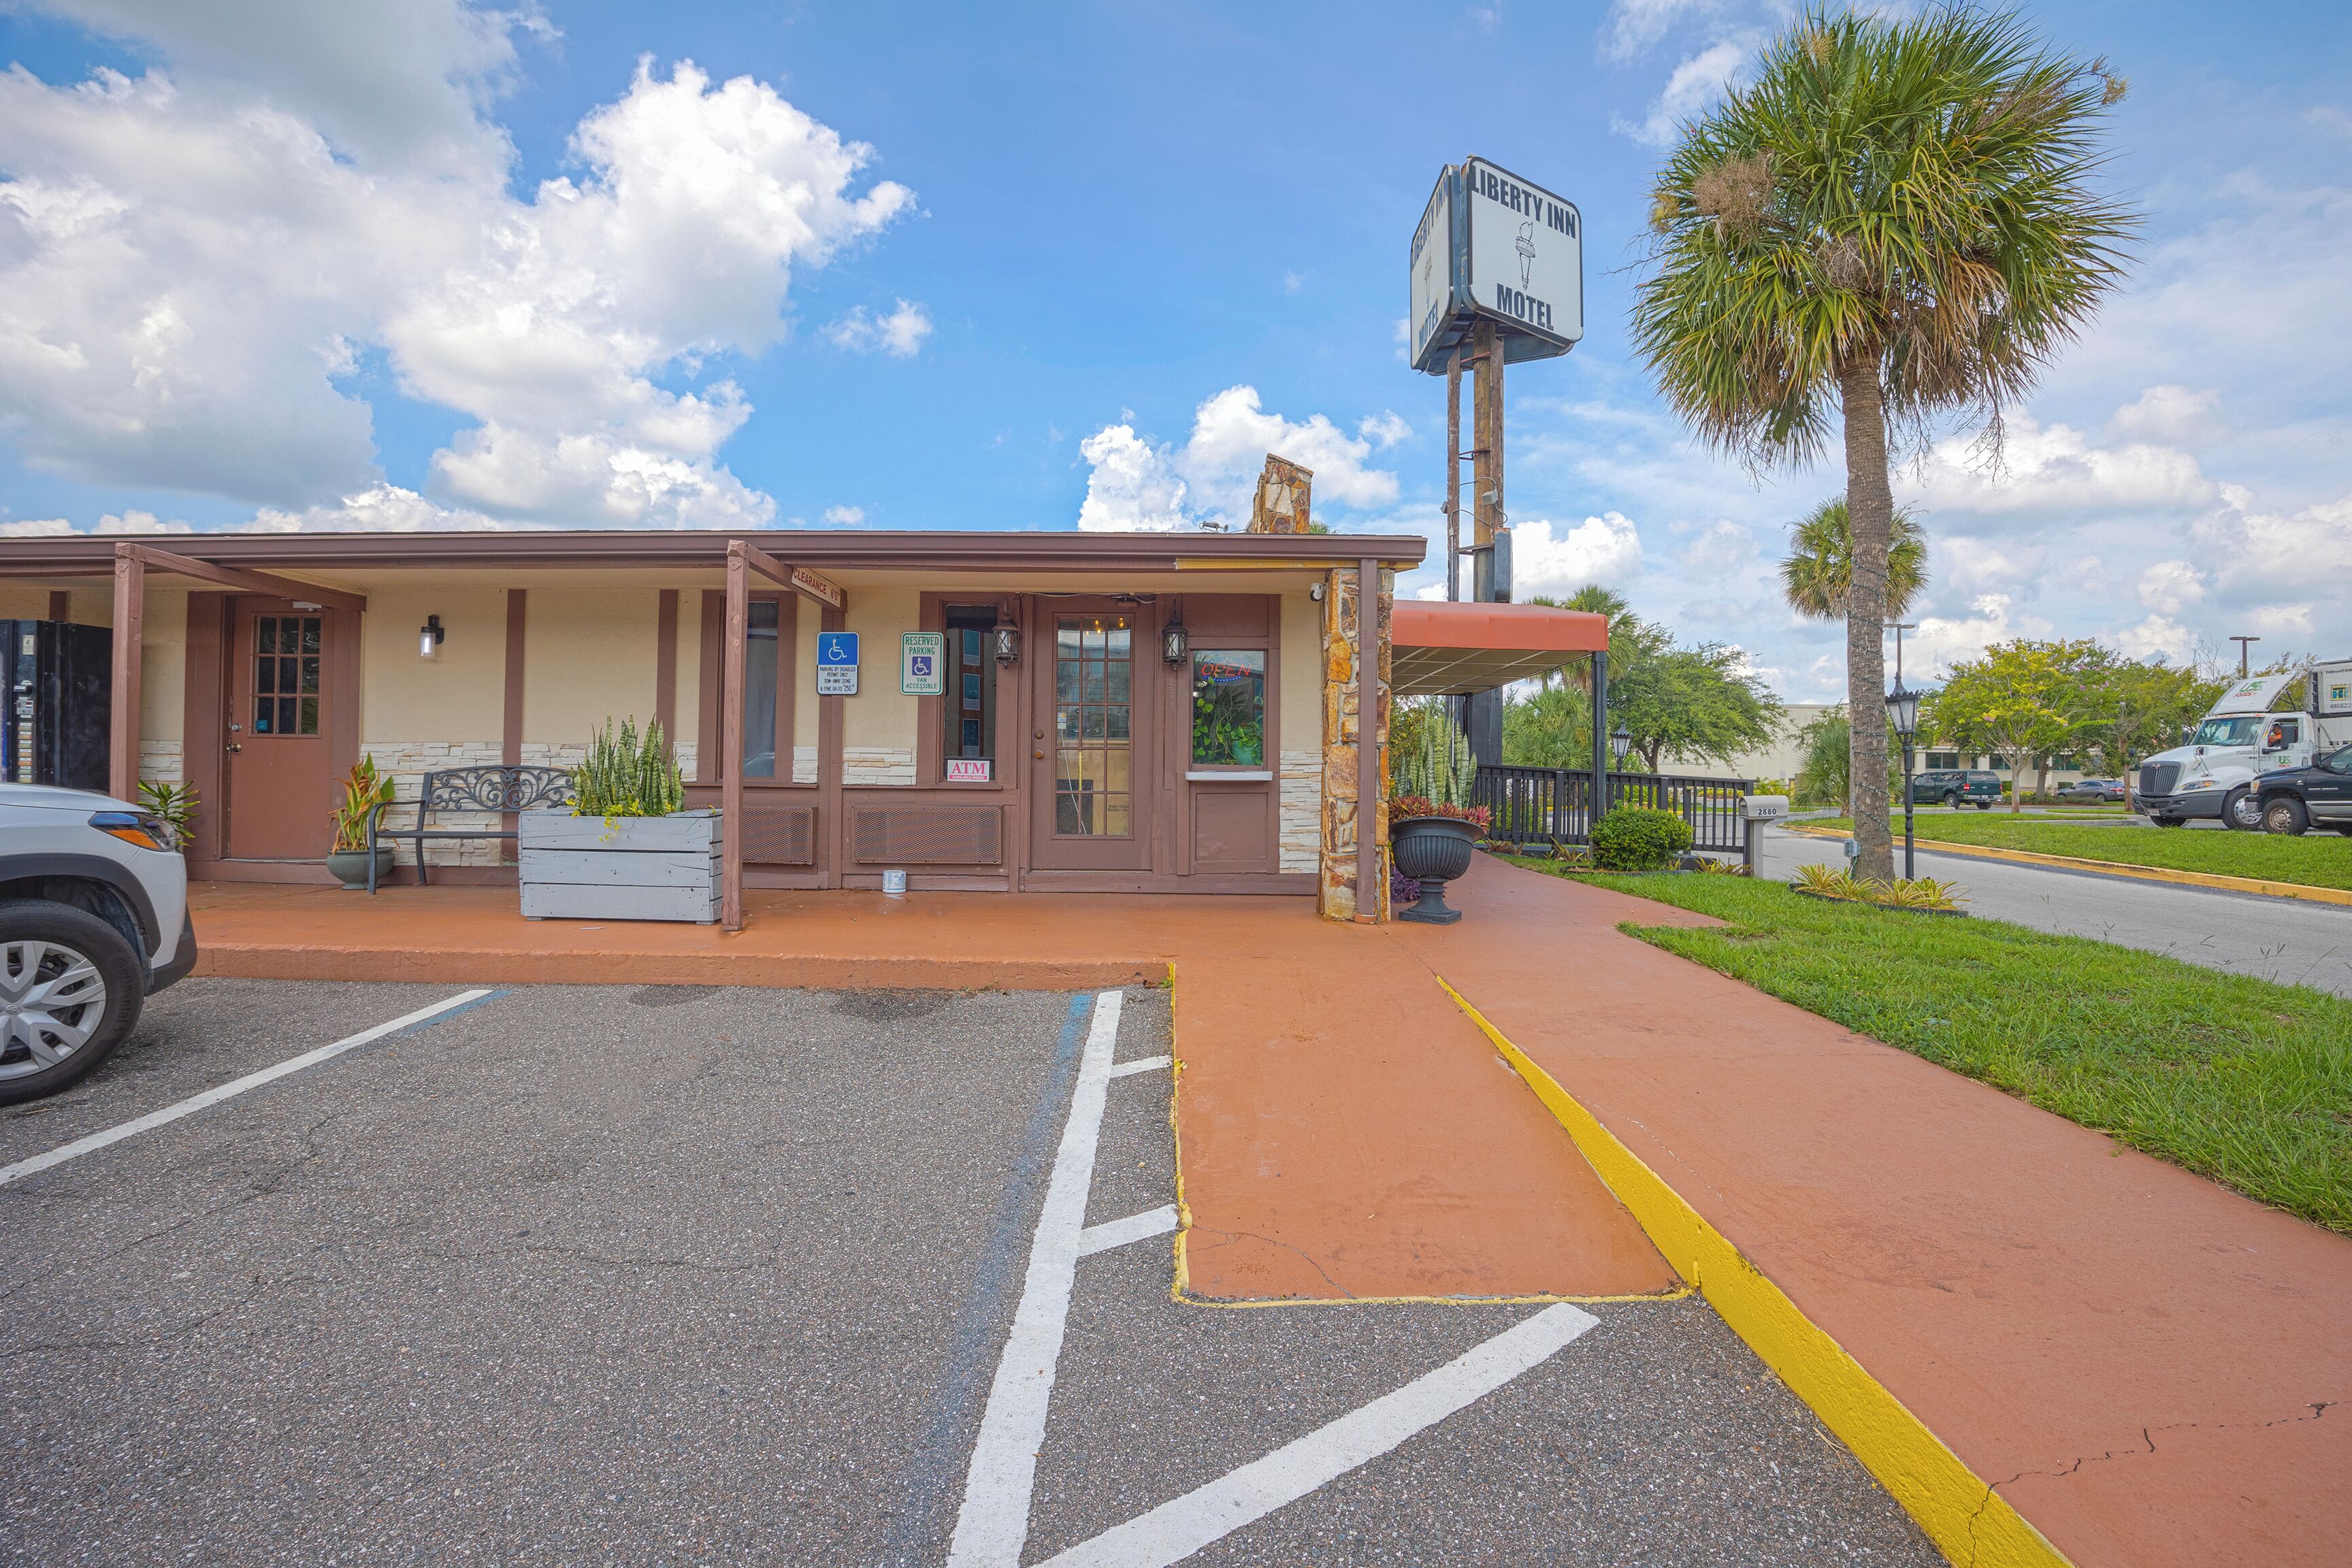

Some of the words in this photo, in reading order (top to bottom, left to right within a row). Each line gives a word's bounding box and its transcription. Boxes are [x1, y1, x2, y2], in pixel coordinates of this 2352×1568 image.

[1469, 164, 1543, 222] LIBERTY
[1548, 201, 1575, 239] INN
[1411, 201, 1435, 272] LIBERTY
[1497, 283, 1554, 331] MOTEL
[1419, 299, 1438, 354] MOTEL
[794, 568, 827, 595] CLEARANCE
[905, 636, 939, 645] RESERVED
[1200, 664, 1252, 676] OPEN
[951, 762, 985, 774] ATM
